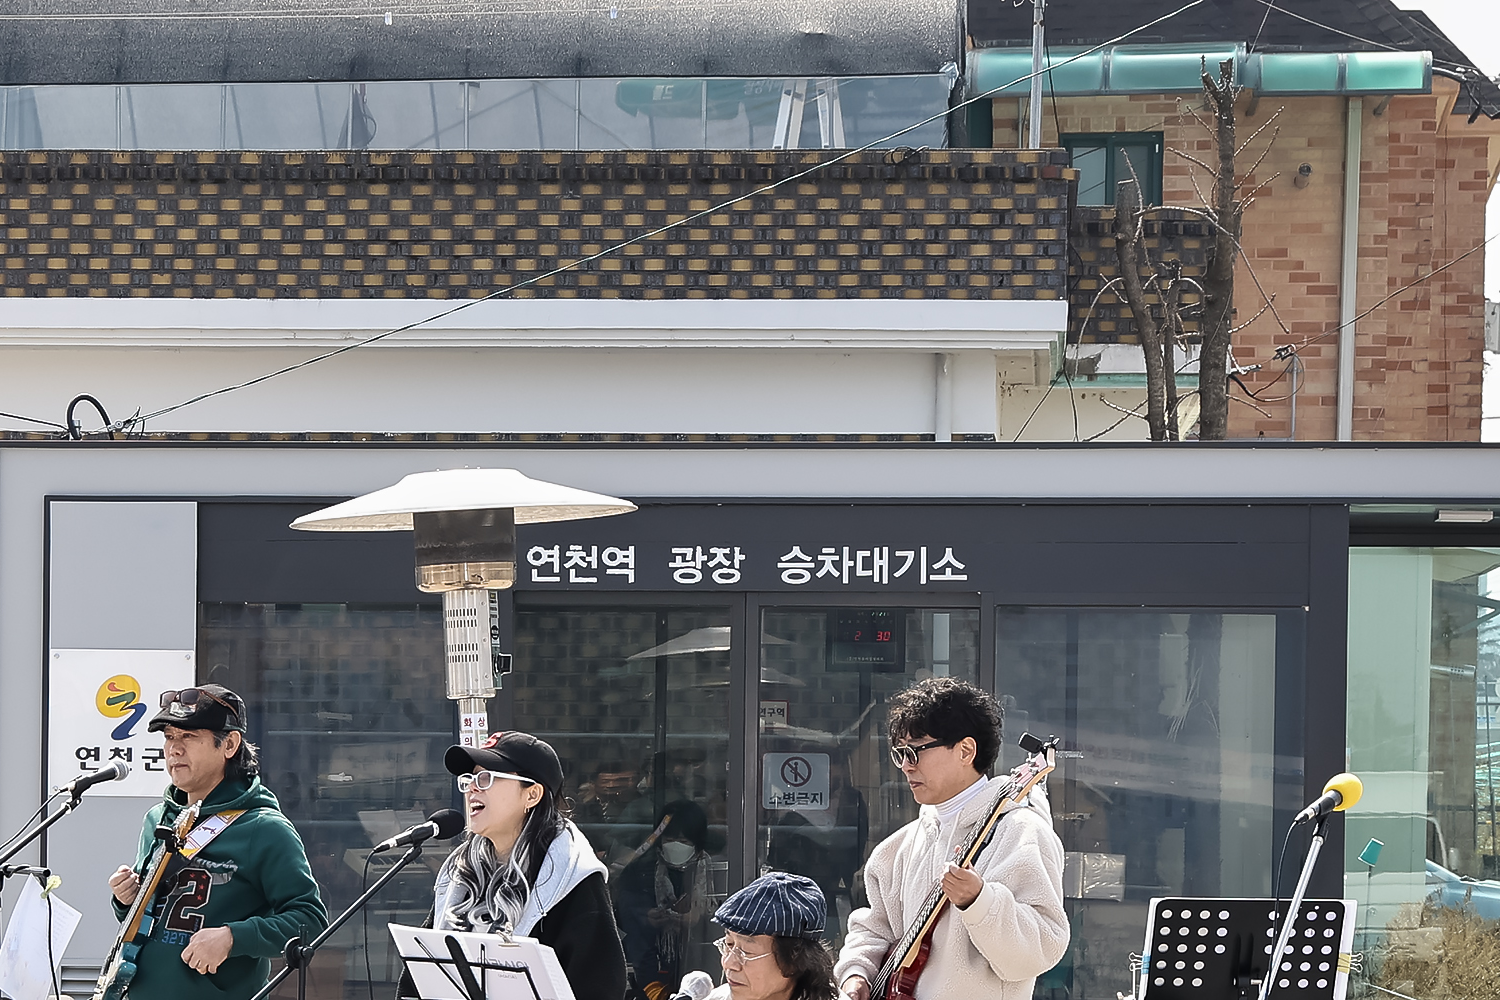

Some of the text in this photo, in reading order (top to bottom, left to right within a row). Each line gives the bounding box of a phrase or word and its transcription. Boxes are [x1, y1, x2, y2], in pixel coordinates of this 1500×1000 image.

[526, 544, 968, 584] 연천역 광장 승차대기소
[769, 791, 823, 806] 소변금지
